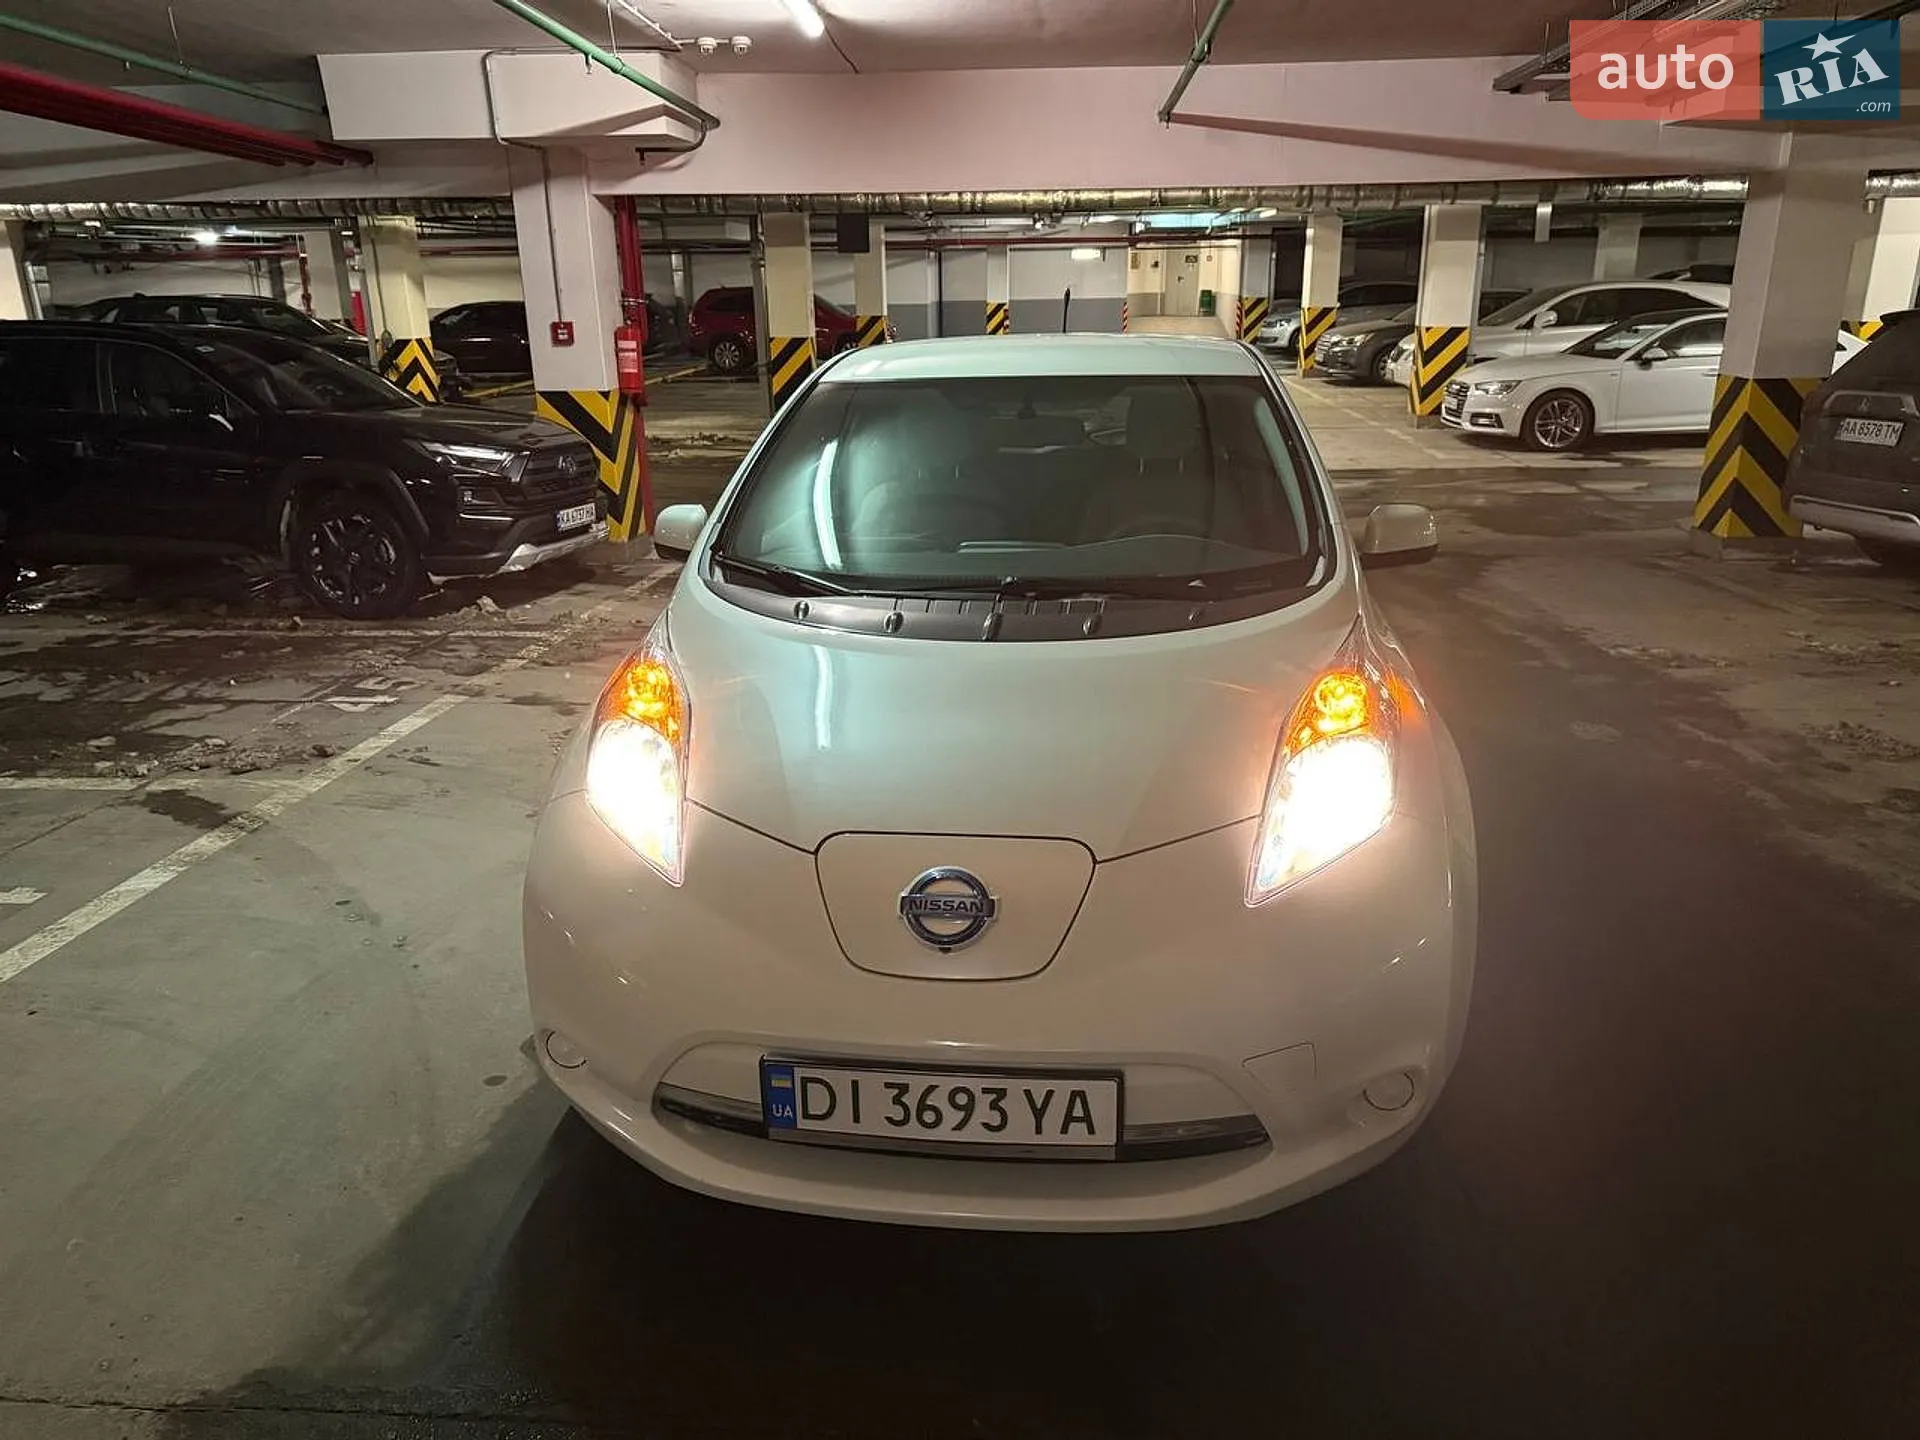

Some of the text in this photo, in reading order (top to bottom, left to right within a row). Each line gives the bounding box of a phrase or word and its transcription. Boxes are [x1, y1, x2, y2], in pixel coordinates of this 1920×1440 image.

[908, 899, 984, 913] NISSAN
[772, 1103, 793, 1118] UA
[800, 1076, 1096, 1136] DI 3693 YA
